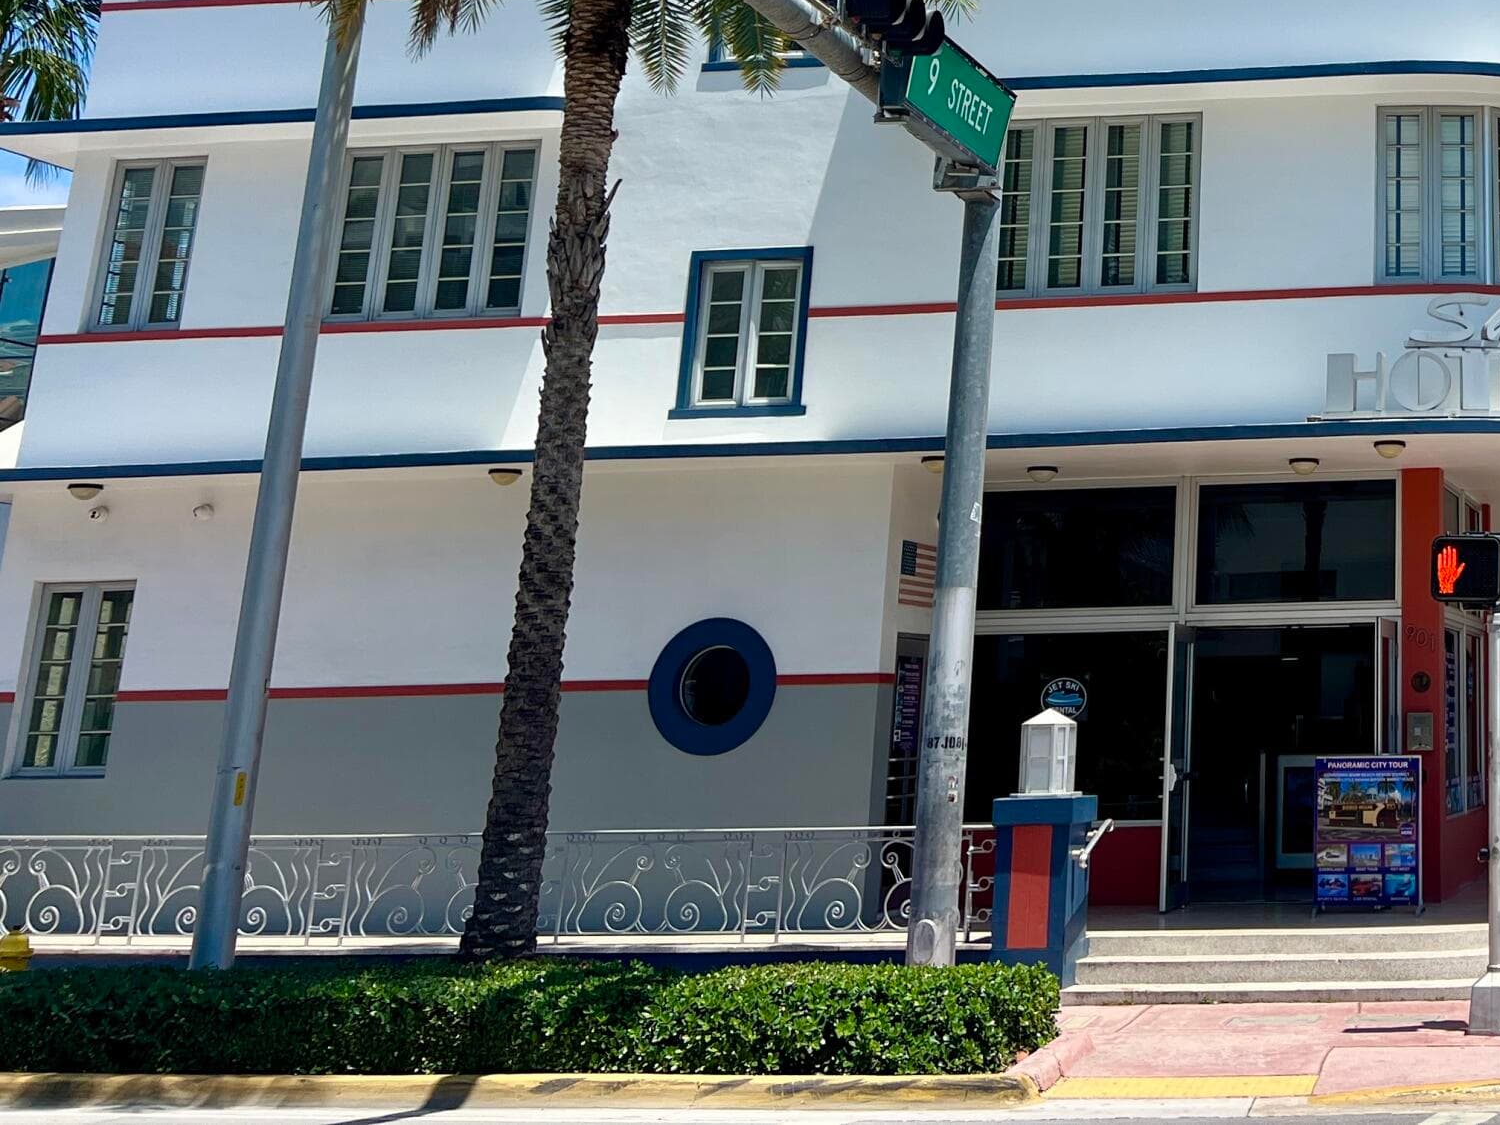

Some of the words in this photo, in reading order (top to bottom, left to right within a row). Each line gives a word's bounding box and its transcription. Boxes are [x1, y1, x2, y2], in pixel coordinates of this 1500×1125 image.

[927, 58, 940, 95] 9
[947, 78, 993, 135] STREET
[1404, 625, 1436, 651] 901
[1048, 681, 1063, 693] JET
[1065, 681, 1080, 691] SKI
[1327, 761, 1370, 769] PANORAMIC
[1370, 761, 1388, 769] CITY
